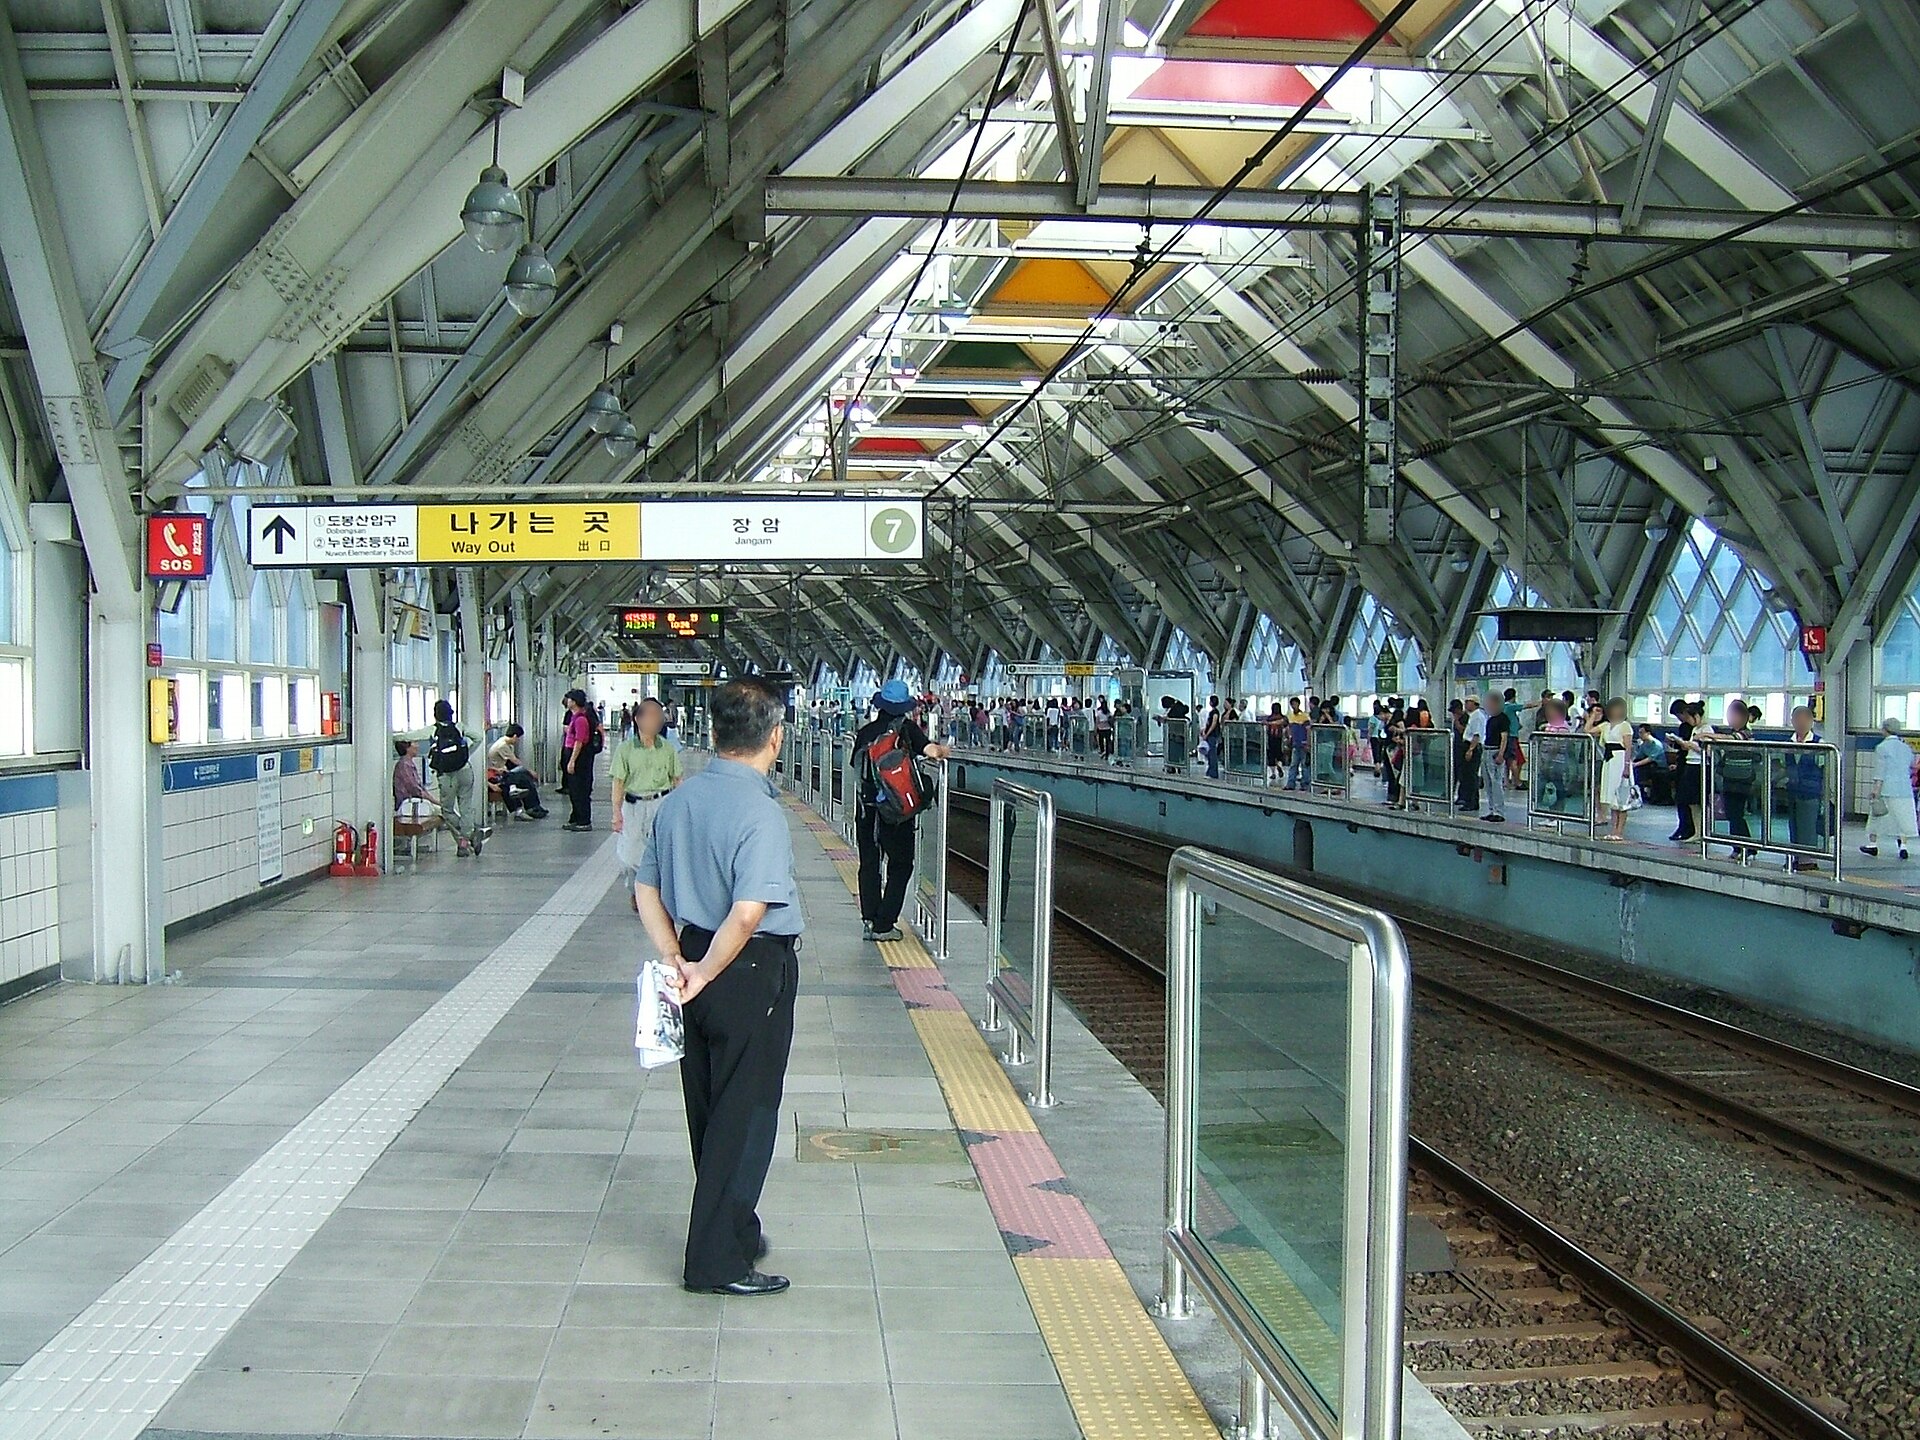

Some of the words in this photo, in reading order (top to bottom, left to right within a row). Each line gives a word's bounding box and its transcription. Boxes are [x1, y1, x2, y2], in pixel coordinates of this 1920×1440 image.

[327, 515, 397, 527] 도봉산입구
[583, 511, 610, 533] 곳
[884, 518, 903, 544] 7
[327, 536, 410, 548] 누원초등학교
[451, 540, 481, 555] Way
[488, 540, 516, 553] Out
[734, 537, 772, 546] Jangam
[347, 549, 387, 557] Elementary
[160, 559, 193, 571] SOS
